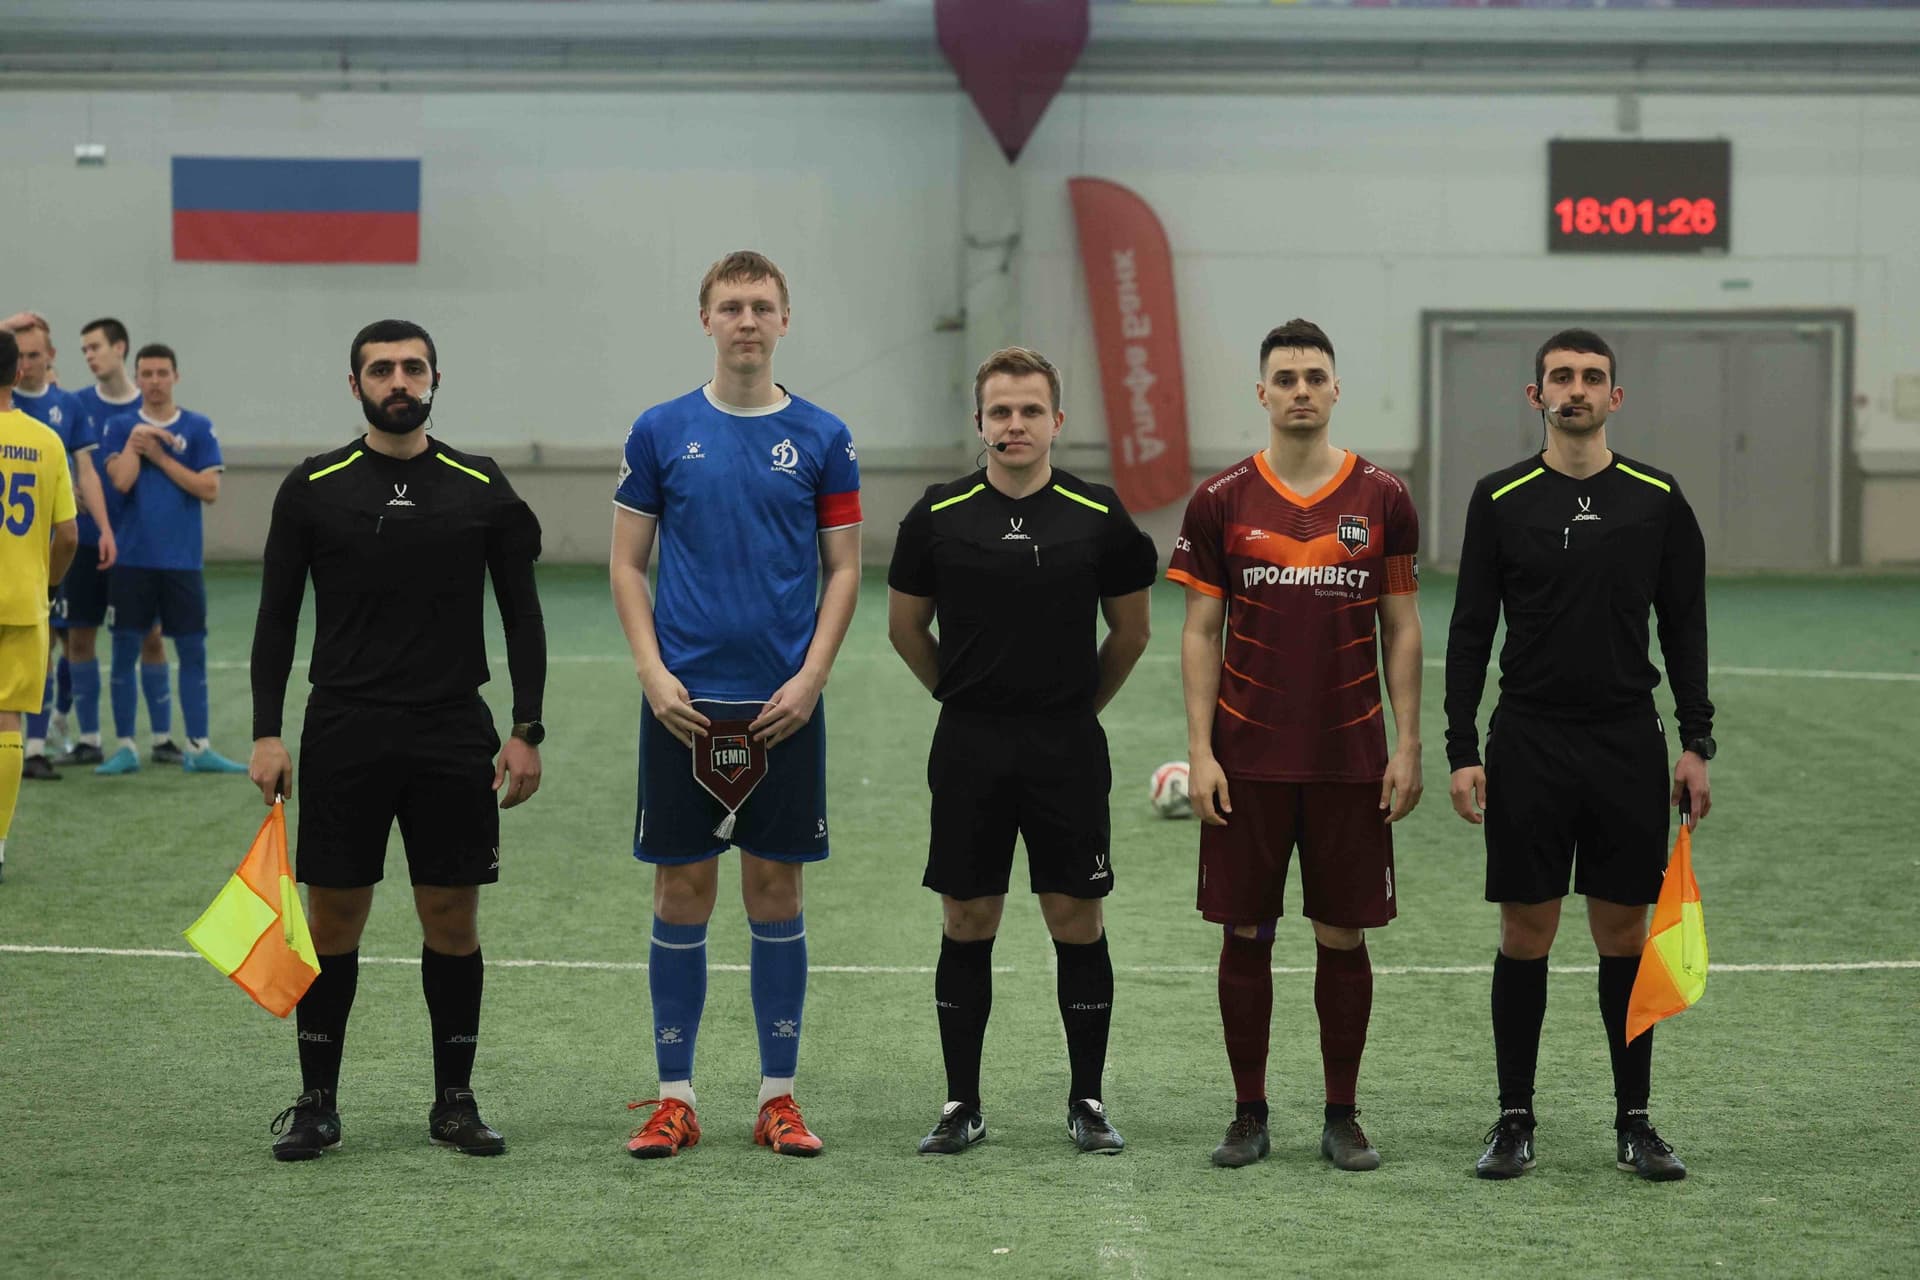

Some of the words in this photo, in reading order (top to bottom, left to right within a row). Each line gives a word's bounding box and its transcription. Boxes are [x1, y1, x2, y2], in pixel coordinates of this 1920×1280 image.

[1554, 197, 1717, 235] 18:01:26
[0, 471, 36, 537] 5
[1340, 526, 1367, 544] ТЕМП
[1242, 565, 1370, 589] ПРОДИНВЕСТ
[714, 748, 747, 767] ТЕМП
